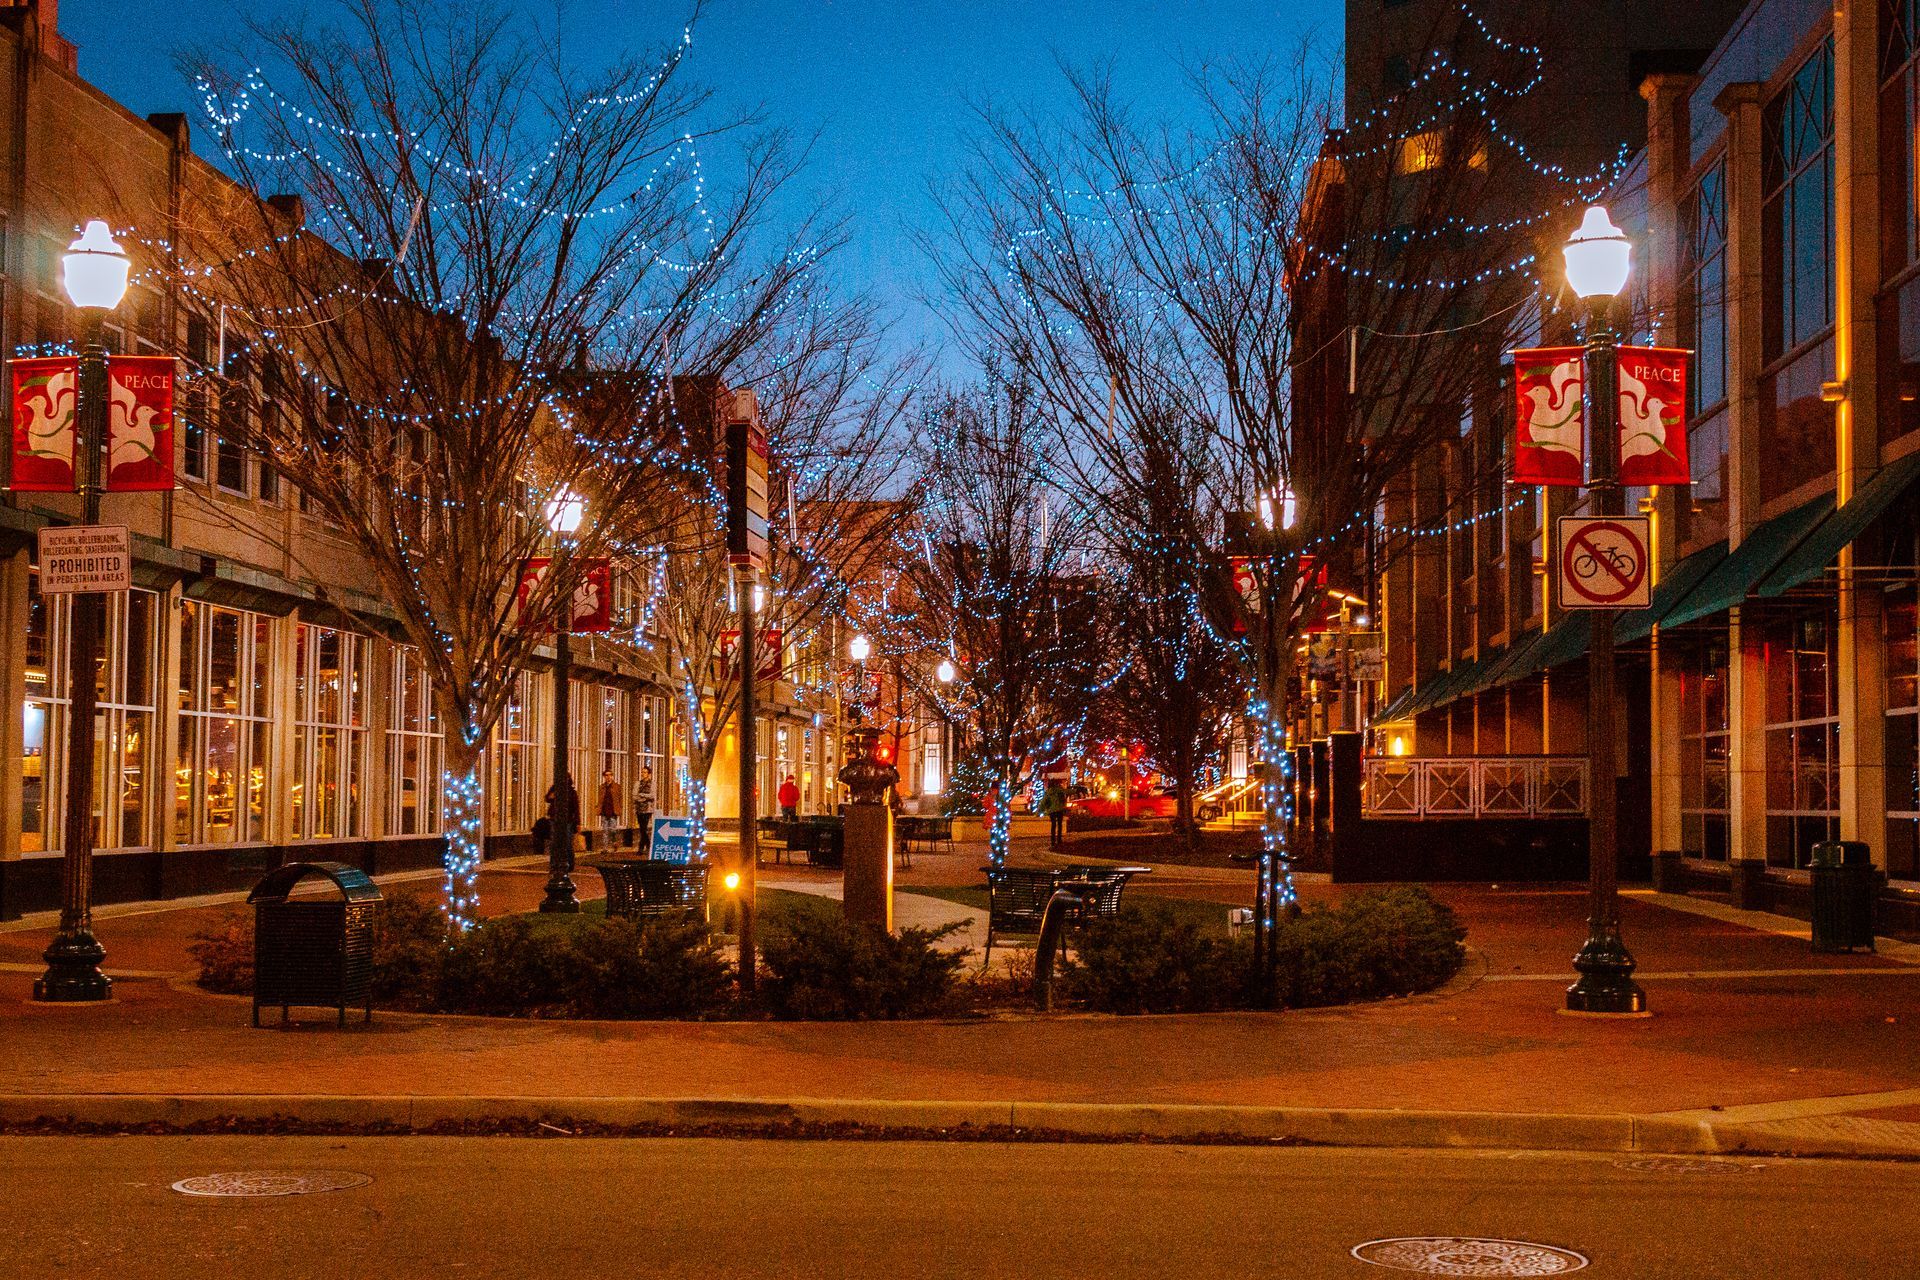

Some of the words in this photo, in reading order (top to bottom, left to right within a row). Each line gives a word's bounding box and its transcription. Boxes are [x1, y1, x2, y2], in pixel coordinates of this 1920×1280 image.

[1634, 365, 1681, 382] PEACE
[124, 375, 169, 389] PEACE
[85, 544, 126, 554] SKATEBOARDING
[50, 557, 120, 574] PROHIBITED
[47, 576, 54, 585] IN
[56, 574, 99, 584] PEDESTRIAN
[102, 573, 125, 583] AREAS
[655, 844, 685, 852] SPECIAL
[653, 851, 685, 861] EVENT
